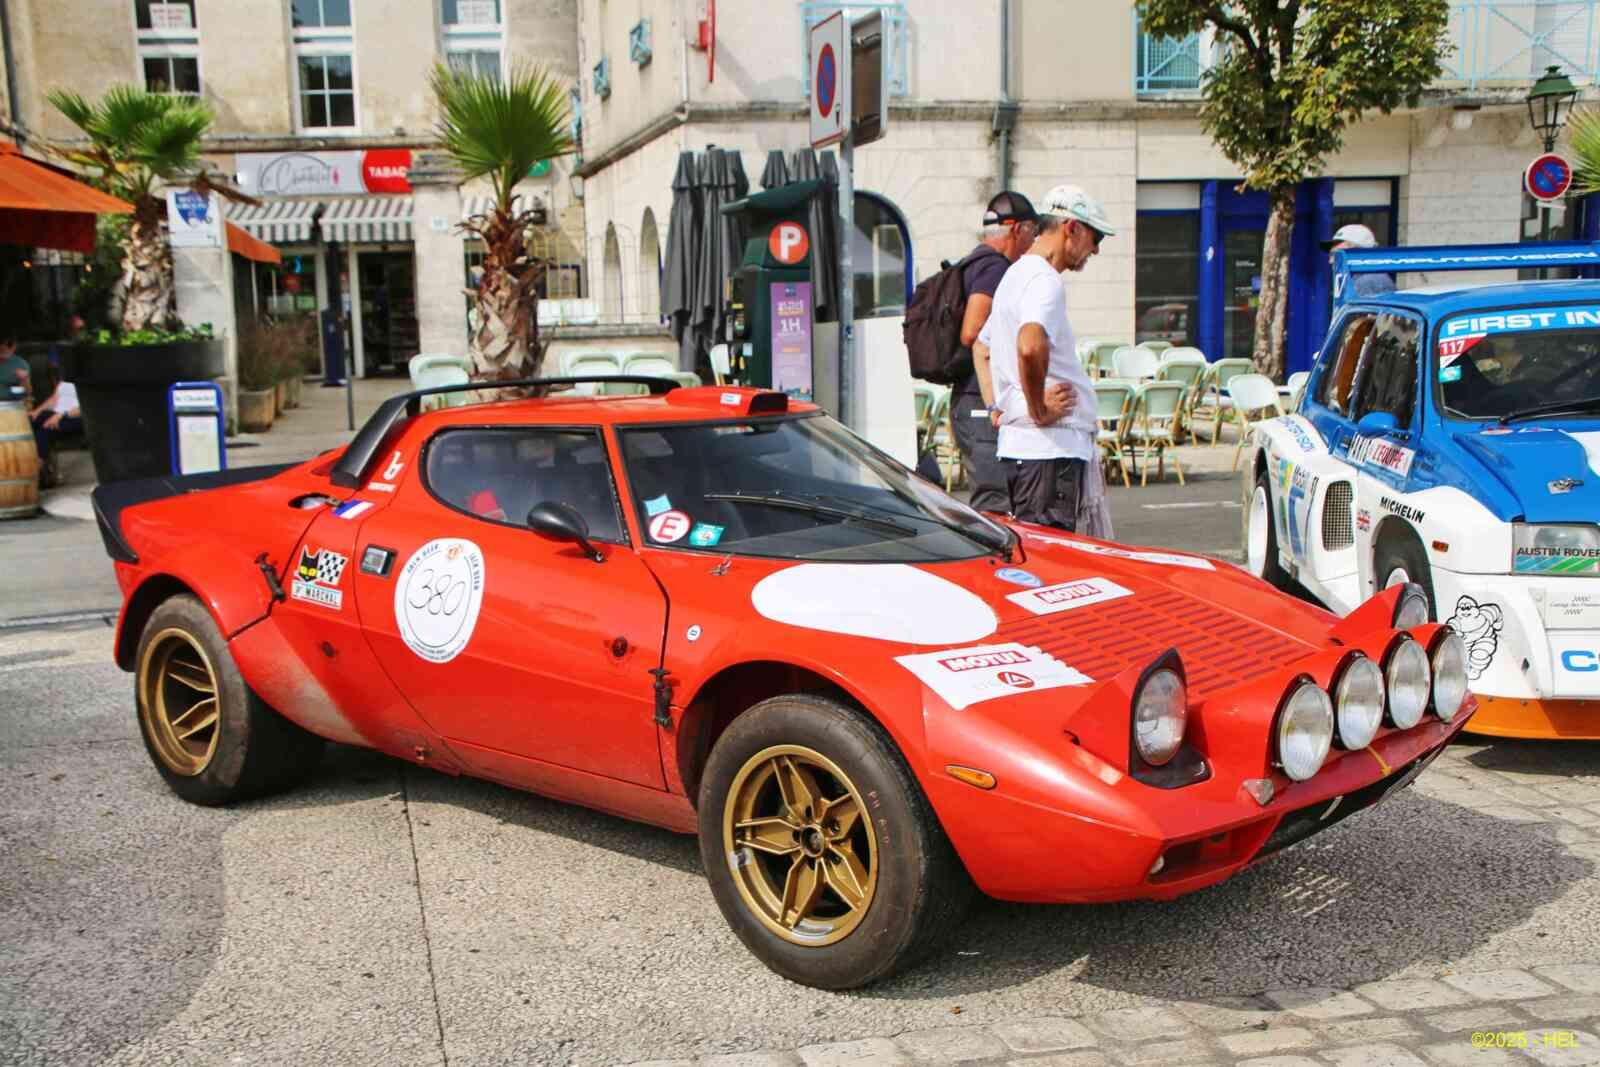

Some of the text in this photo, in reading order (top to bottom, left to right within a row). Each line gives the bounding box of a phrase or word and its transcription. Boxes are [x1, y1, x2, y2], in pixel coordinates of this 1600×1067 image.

[368, 166, 407, 178] TABAC
[780, 226, 801, 260] P
[780, 319, 801, 331] 1H
[1448, 312, 1556, 335] FIRST
[1441, 340, 1465, 354] 117
[1380, 496, 1425, 523] MICHELIN
[656, 516, 682, 540] E
[1517, 547, 1561, 557] AUSTIN
[408, 566, 466, 616] 380
[1039, 584, 1099, 603] MOTUL
[945, 651, 1027, 672] MOTUL
[1560, 650, 1600, 672] C
